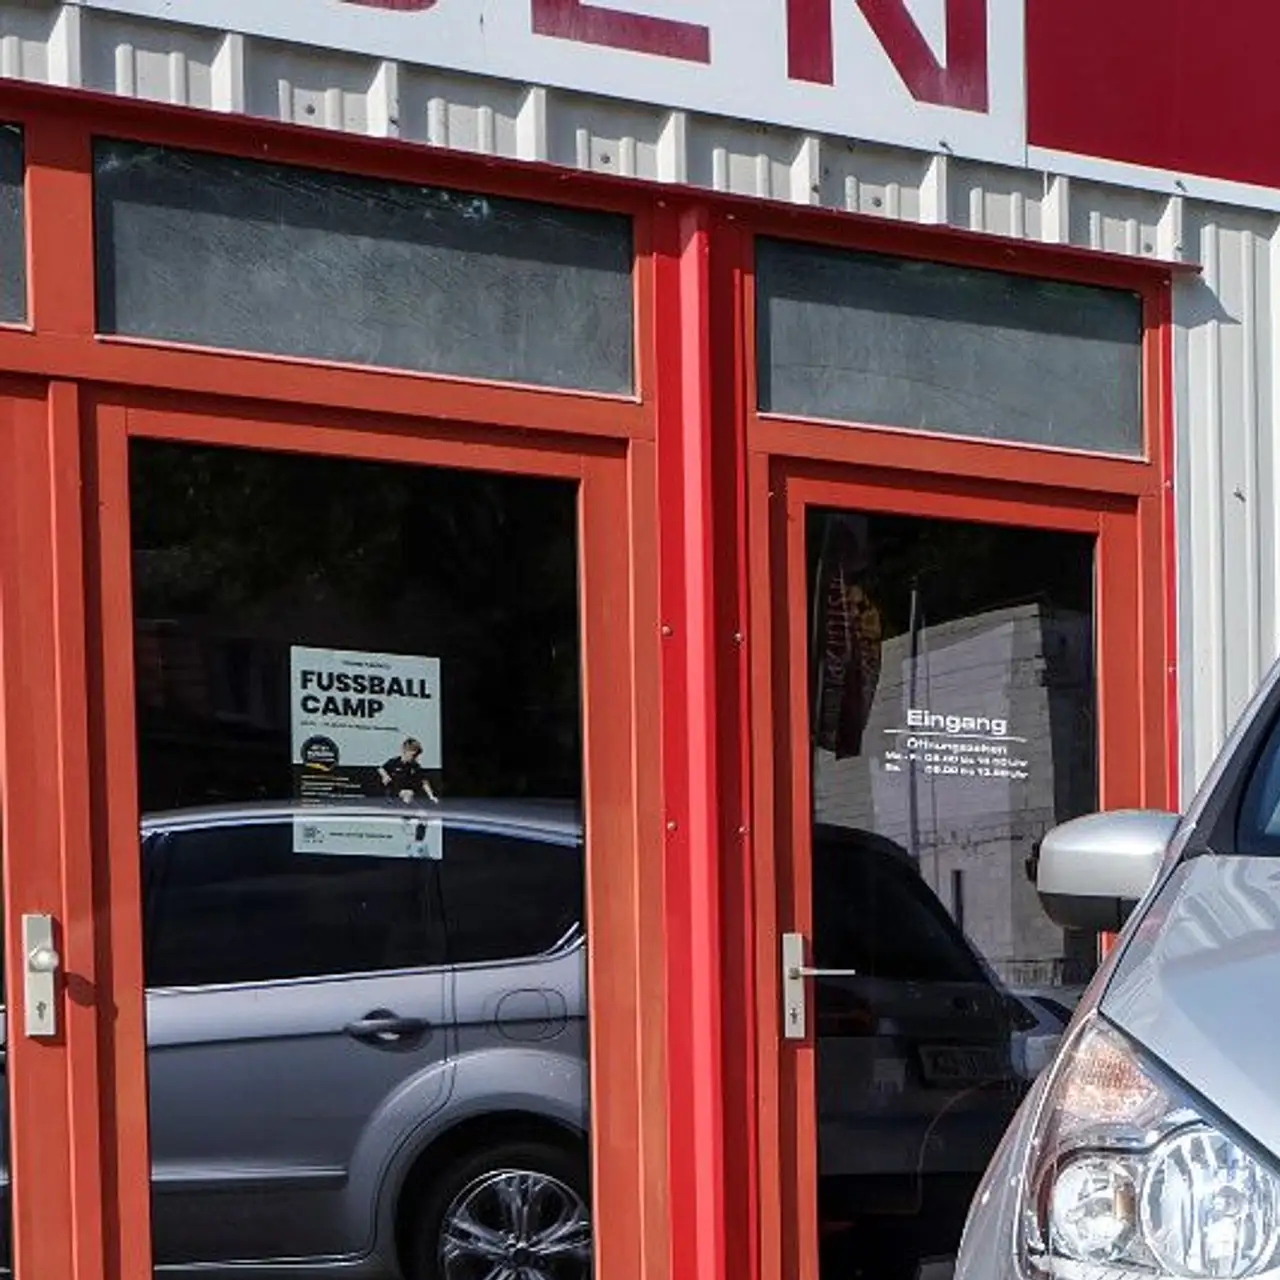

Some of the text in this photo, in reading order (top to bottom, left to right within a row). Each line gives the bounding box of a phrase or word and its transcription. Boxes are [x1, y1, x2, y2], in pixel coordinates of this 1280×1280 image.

[301, 670, 432, 699] FUSSBALL
[301, 695, 384, 718] CAMP
[907, 709, 1007, 735] Eingang
